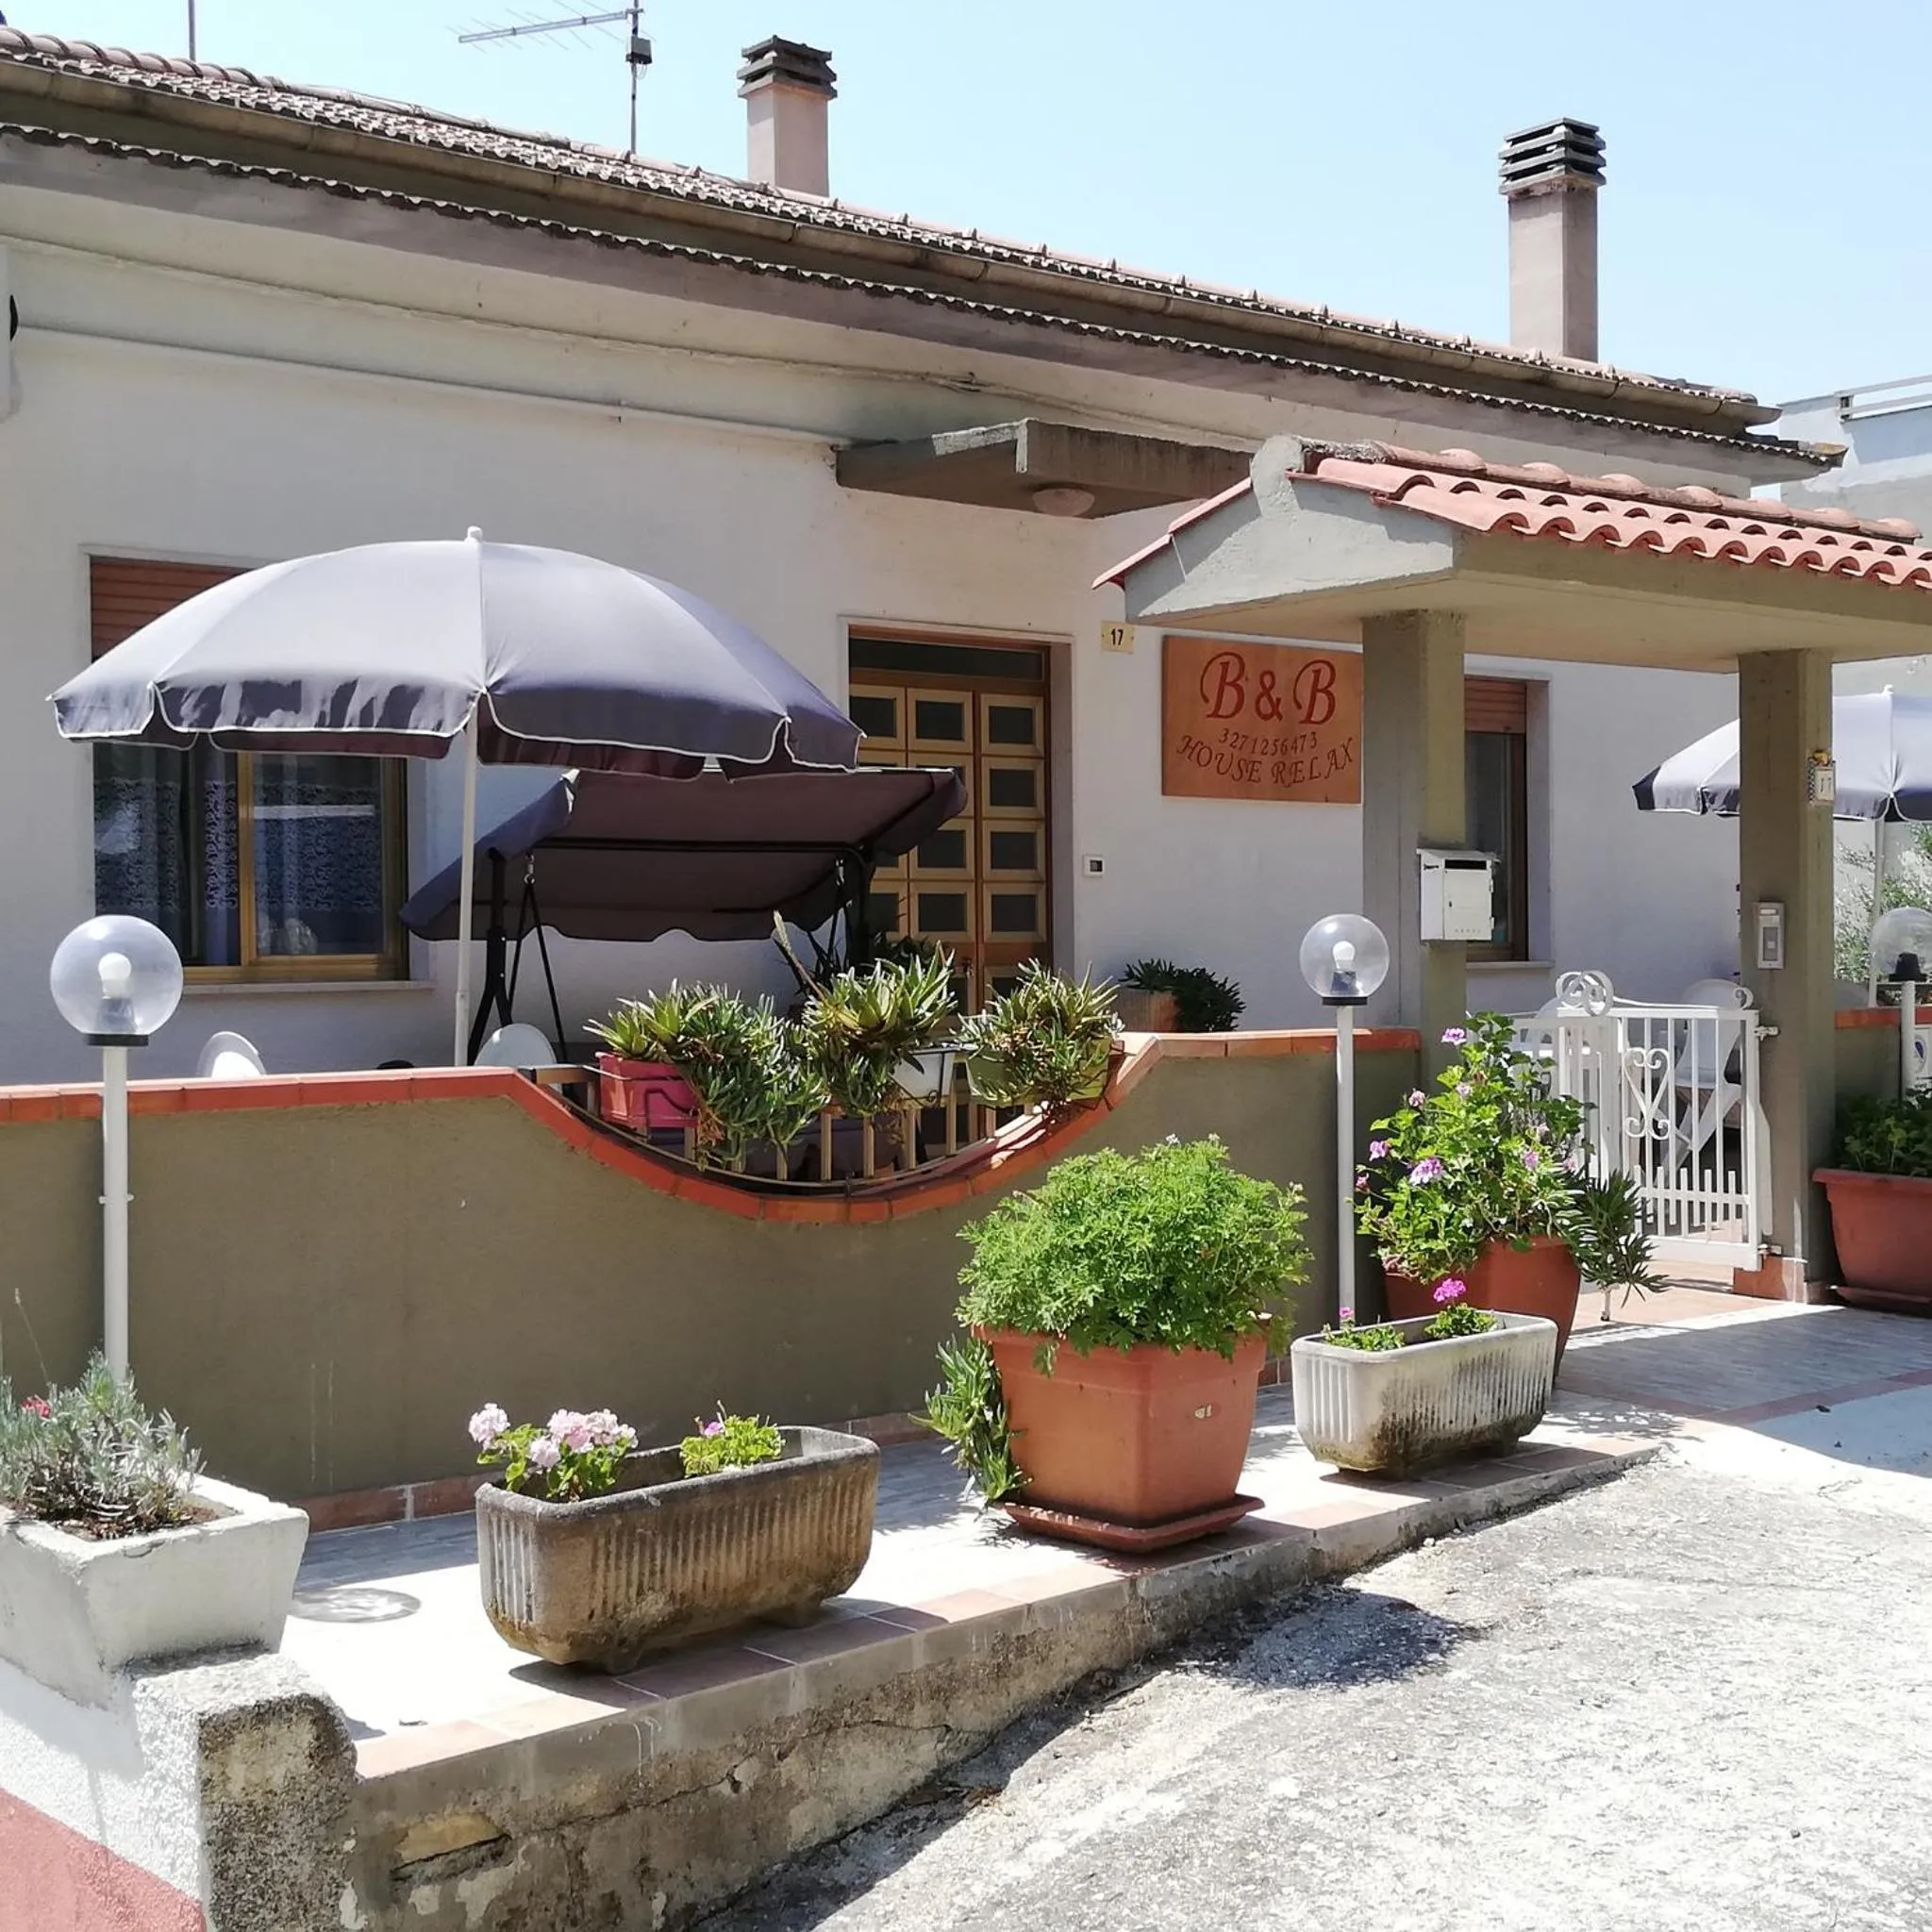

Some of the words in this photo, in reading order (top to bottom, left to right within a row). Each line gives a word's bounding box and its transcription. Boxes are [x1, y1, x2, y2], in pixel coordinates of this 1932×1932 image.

[1110, 628, 1124, 646] 17
[1219, 727, 1318, 757] 3271256473
[1176, 735, 1262, 784] HOUSE
[1272, 737, 1354, 789] RELAX
